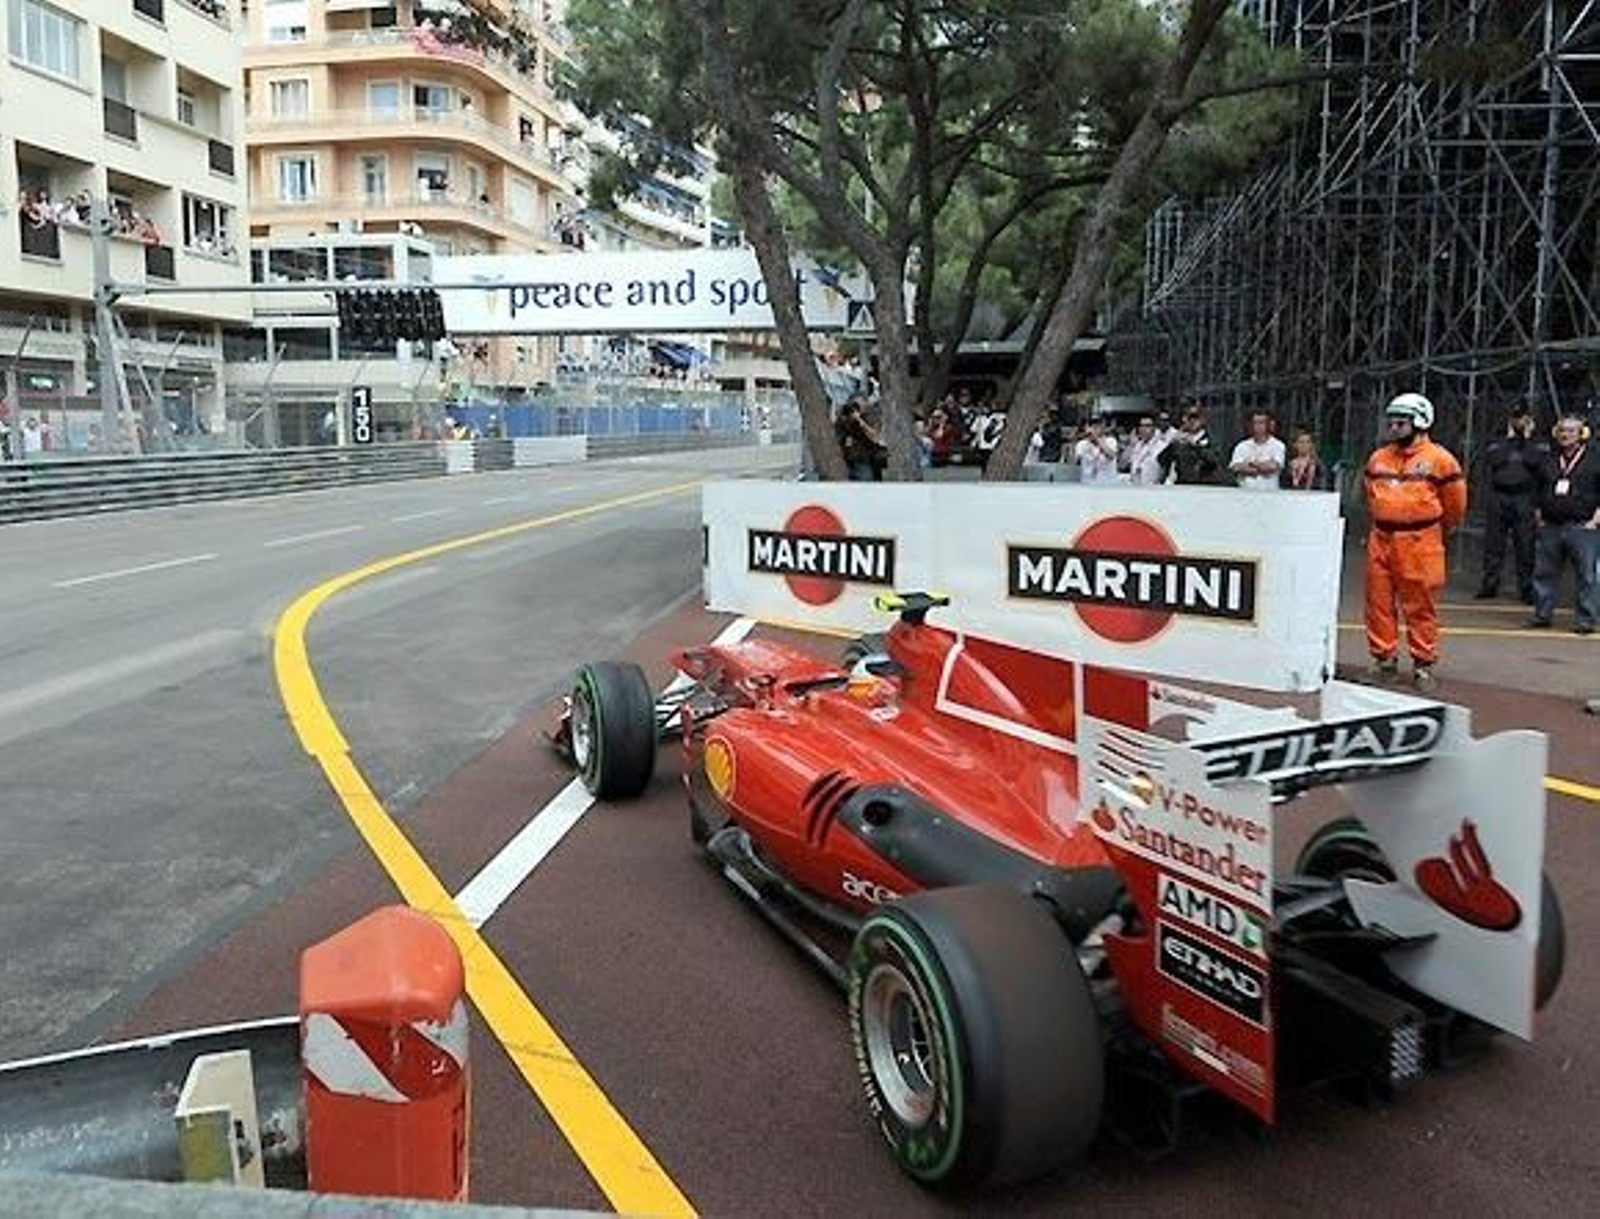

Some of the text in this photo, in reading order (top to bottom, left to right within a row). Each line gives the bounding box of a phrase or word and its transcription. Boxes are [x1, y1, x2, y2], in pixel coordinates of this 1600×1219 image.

[508, 268, 807, 319] peace and spot
[354, 389, 370, 441] 150
[753, 535, 887, 578] MARTINI
[1017, 553, 1242, 611] MARTINI
[1203, 714, 1441, 783] ETIHAD
[1159, 783, 1267, 843] V-Power
[1118, 806, 1267, 897] Santander
[1162, 881, 1236, 936] AMD
[1163, 936, 1262, 999] ETIHAD
